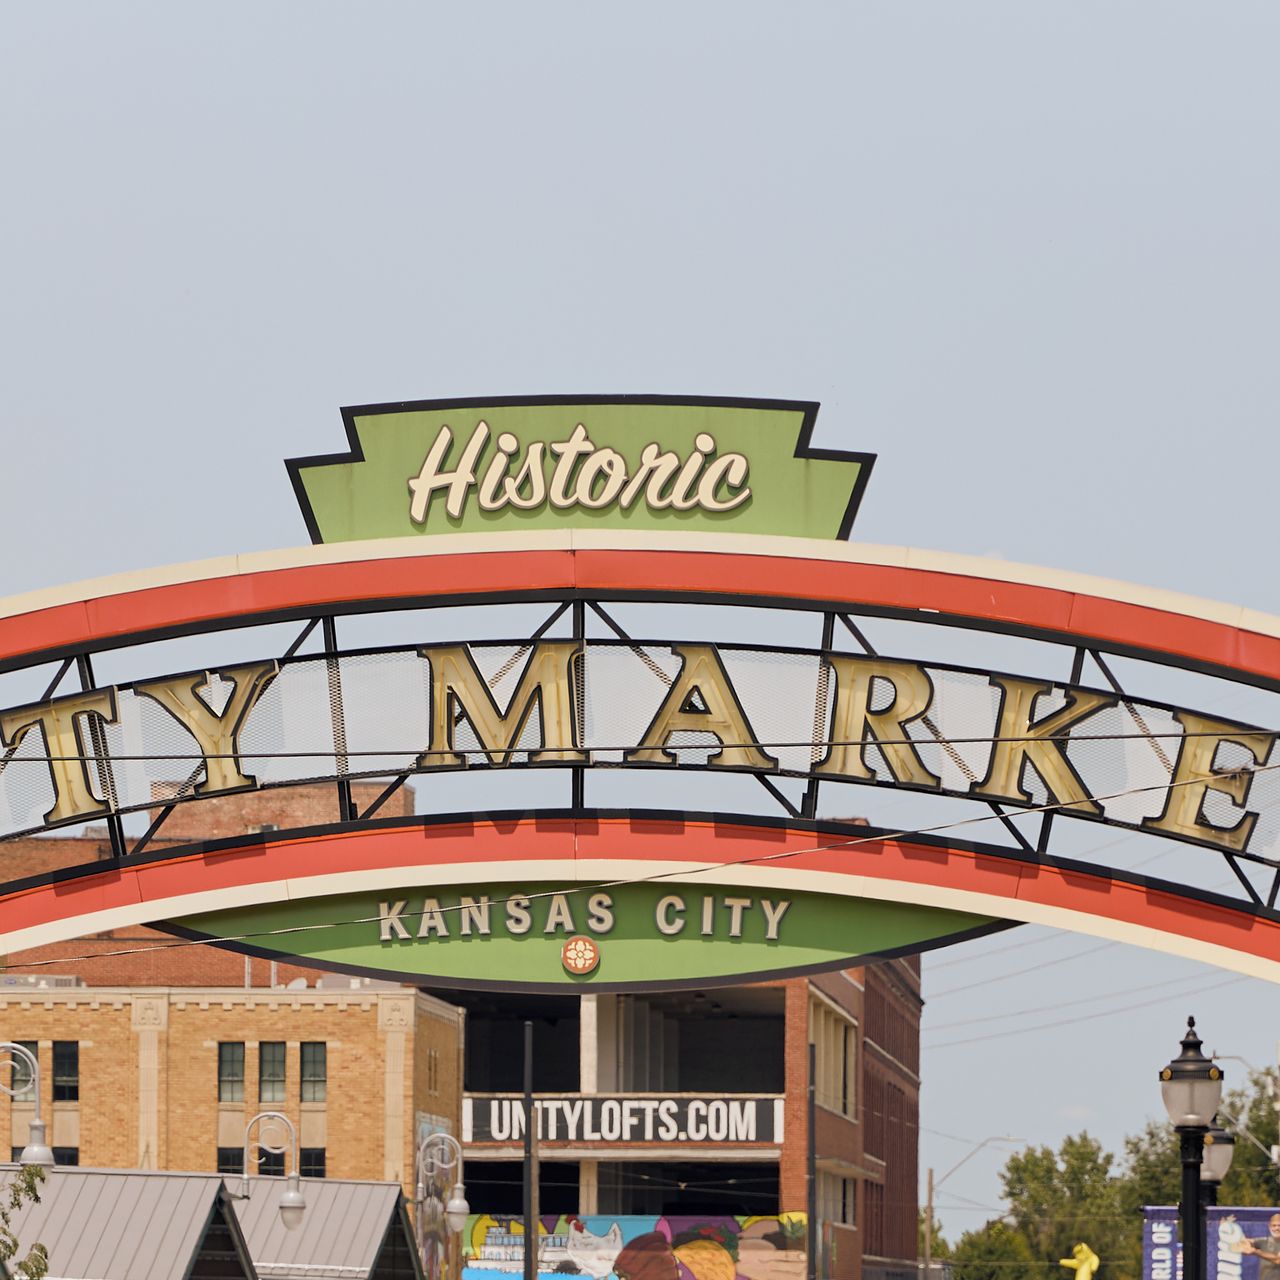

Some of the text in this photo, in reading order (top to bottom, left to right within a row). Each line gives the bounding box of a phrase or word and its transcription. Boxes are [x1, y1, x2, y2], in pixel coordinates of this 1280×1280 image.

[408, 421, 752, 524] Historic
[377, 893, 793, 942] KANSAS CITY
[490, 1099, 757, 1141] UNITYLOFTS.COM
[1151, 1222, 1172, 1245] OF
